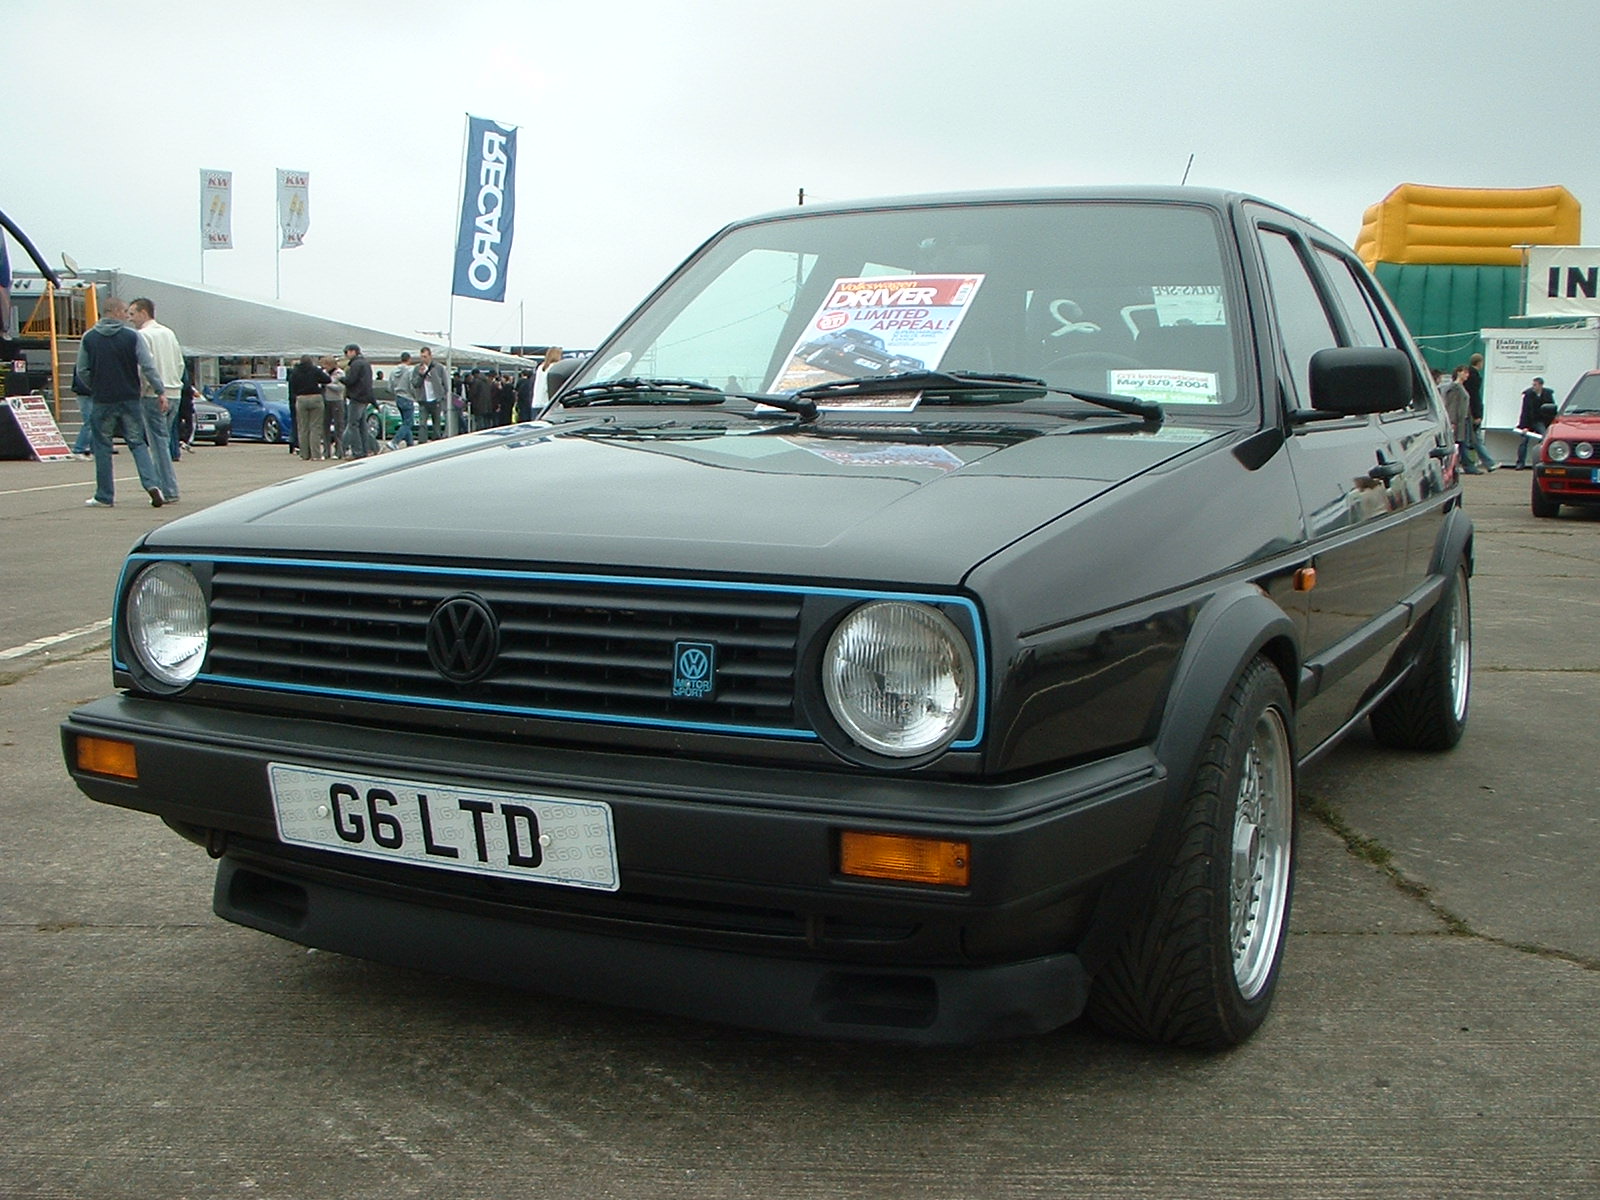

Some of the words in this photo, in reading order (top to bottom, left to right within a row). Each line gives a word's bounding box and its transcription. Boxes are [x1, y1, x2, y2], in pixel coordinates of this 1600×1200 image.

[208, 178, 228, 187] KW
[285, 176, 305, 185] KW
[828, 287, 938, 307] DRIVER
[854, 309, 929, 321] LIMITED
[870, 320, 954, 331] APPEAL!
[1117, 379, 1144, 388] May
[1176, 380, 1208, 389] 2004
